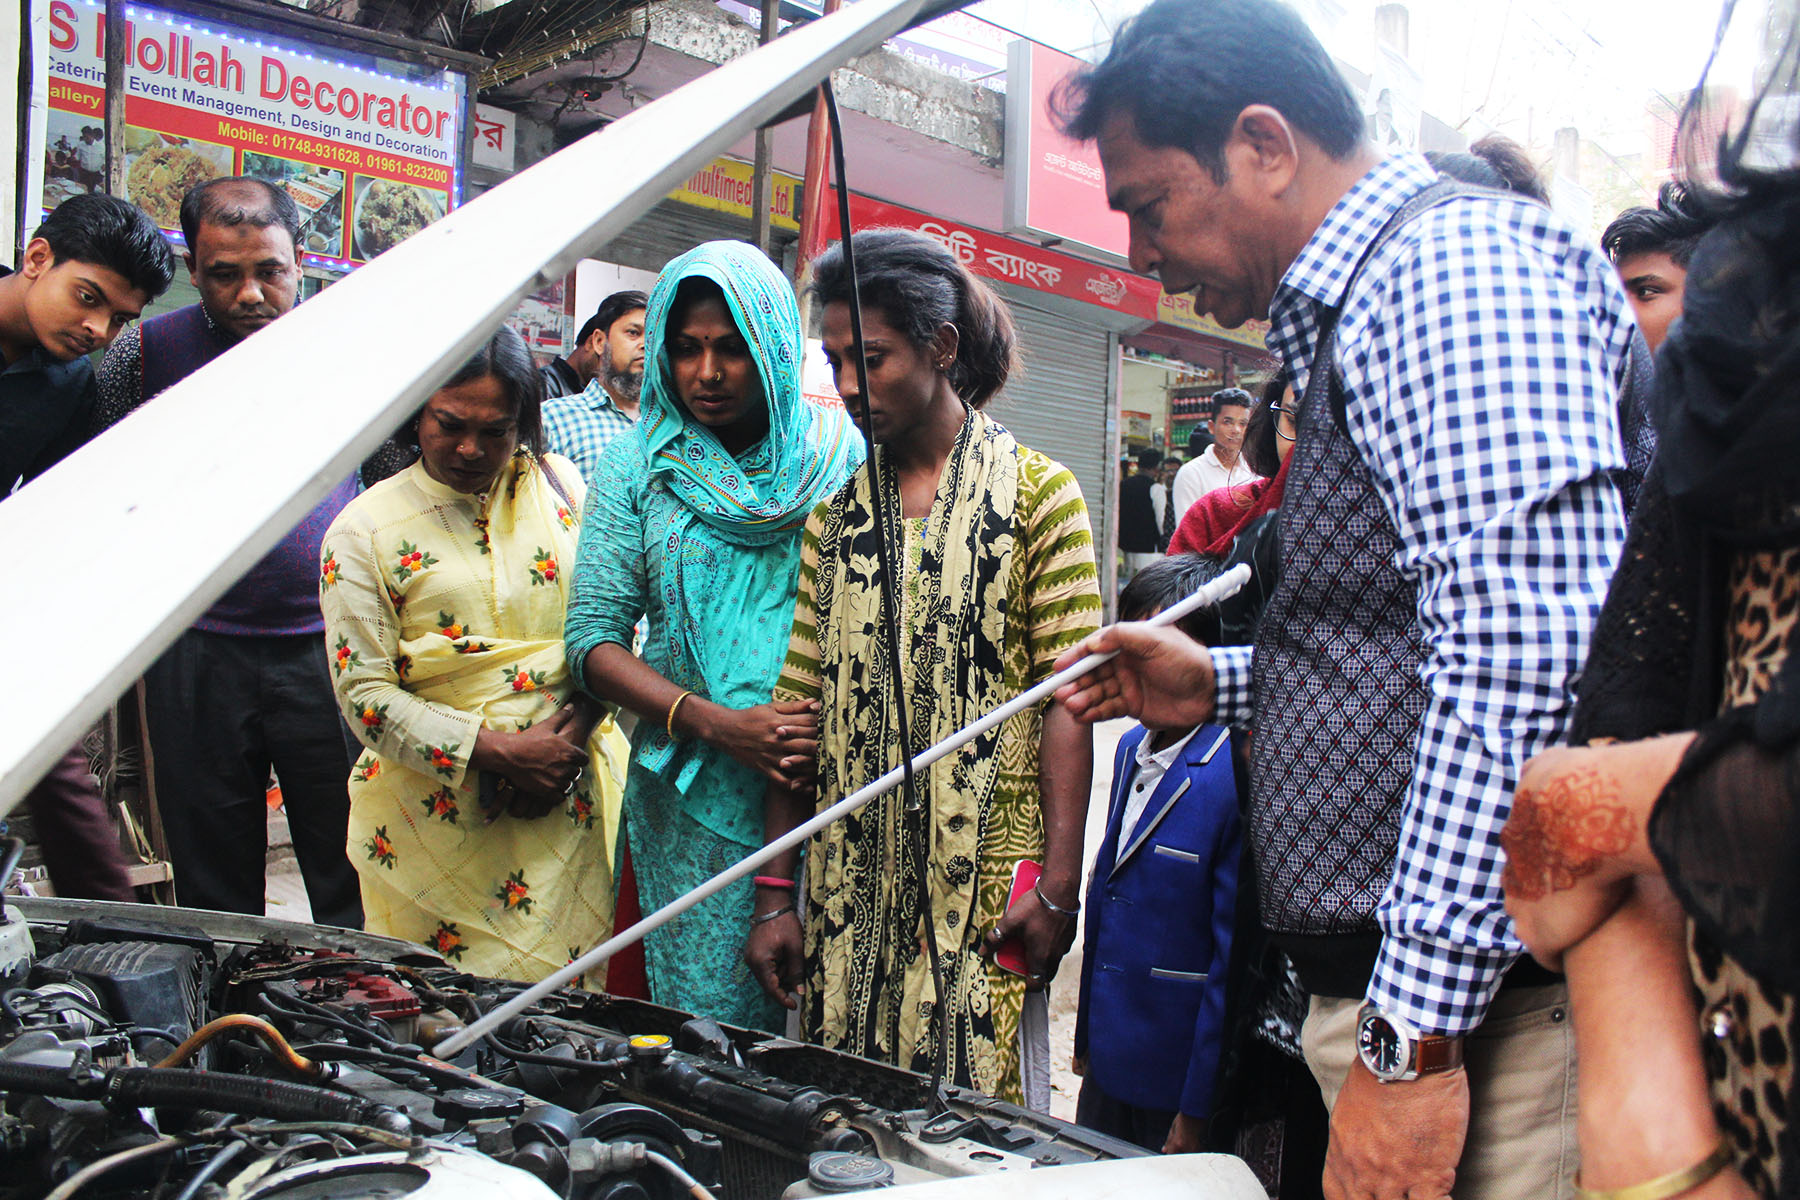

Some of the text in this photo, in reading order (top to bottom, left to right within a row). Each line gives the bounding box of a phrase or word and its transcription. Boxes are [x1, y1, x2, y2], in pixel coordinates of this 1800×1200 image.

[130, 76, 177, 100] Event
[182, 88, 286, 126] Management,
[291, 114, 341, 138] Design
[345, 128, 371, 144] and
[375, 133, 448, 161] Decoration
[260, 56, 452, 140] Decorator
[218, 121, 448, 184] Mobile: 01748-931628, 01961-823200
[984, 248, 1063, 287] ব্যাংক
